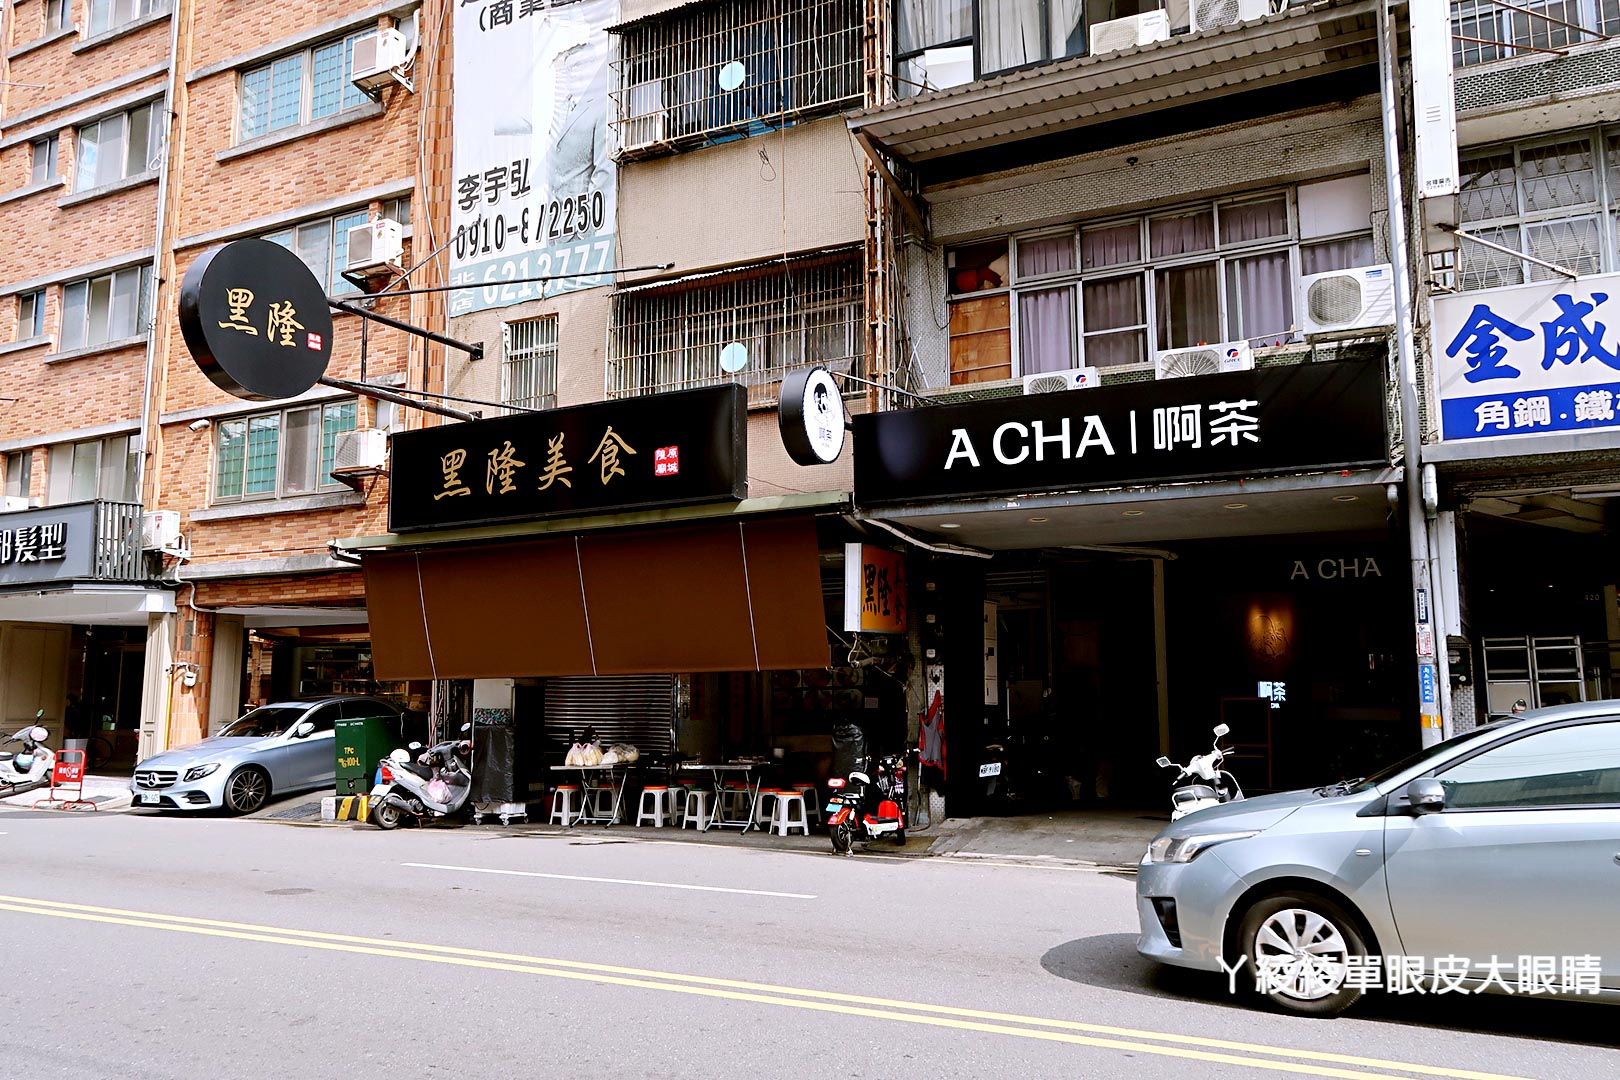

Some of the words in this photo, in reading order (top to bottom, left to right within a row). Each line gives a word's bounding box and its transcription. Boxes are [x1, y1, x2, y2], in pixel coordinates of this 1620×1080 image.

[458, 158, 531, 211] 李宇弘
[482, 241, 611, 305] 6213777
[218, 287, 305, 347] 黑隆
[1446, 292, 1620, 383] 金成
[433, 425, 637, 500] 黑隆美食
[944, 428, 981, 470] A
[992, 415, 1116, 465] CHA
[1153, 399, 1260, 451] 啊茶
[1290, 560, 1309, 580] A
[1317, 557, 1382, 579] CHA
